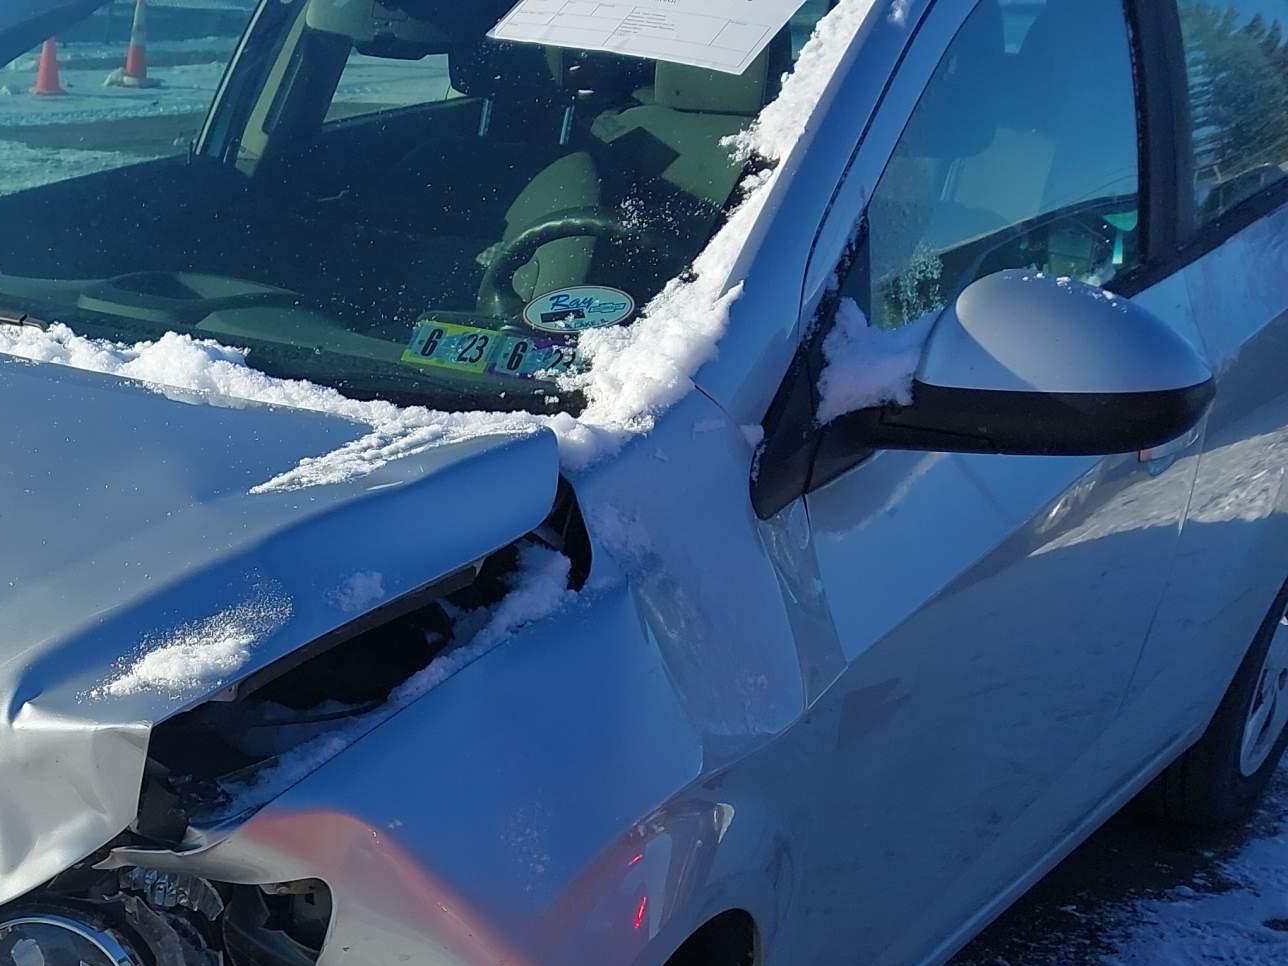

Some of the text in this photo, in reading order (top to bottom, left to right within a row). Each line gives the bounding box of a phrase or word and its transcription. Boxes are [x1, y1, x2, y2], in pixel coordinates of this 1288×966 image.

[549, 294, 594, 311] Ray
[421, 329, 488, 363] 6 23
[506, 341, 528, 370] 6
